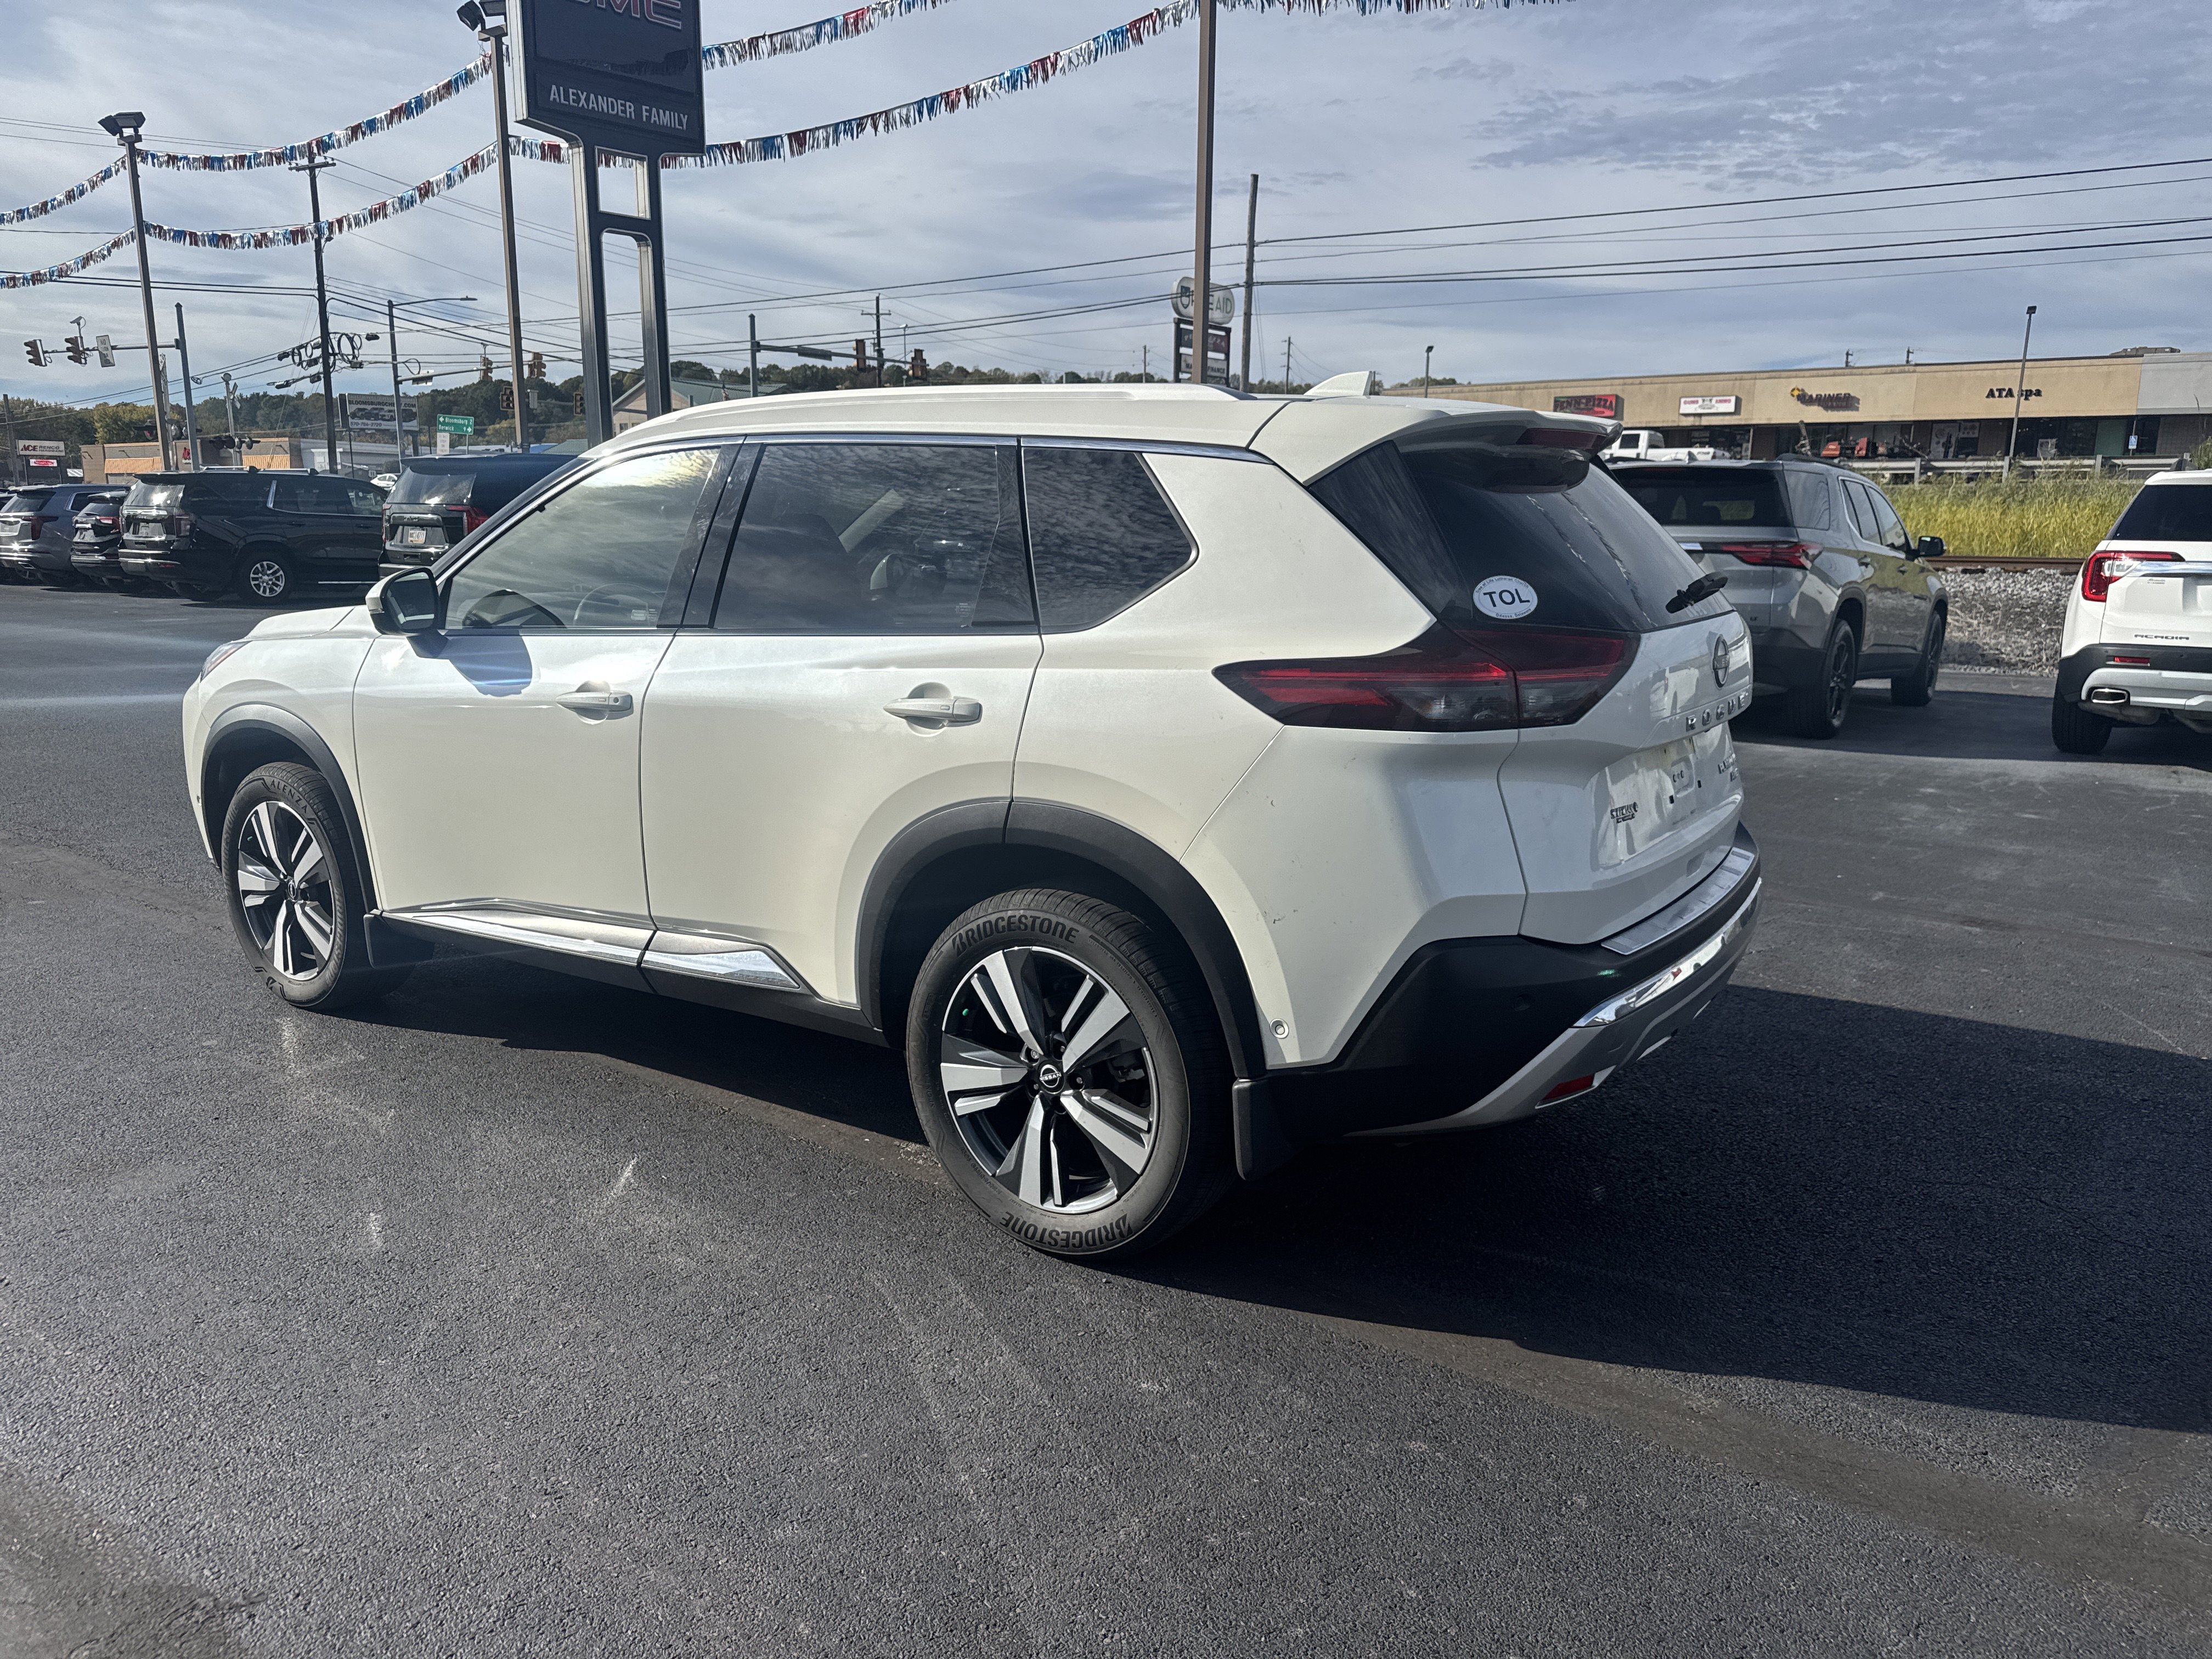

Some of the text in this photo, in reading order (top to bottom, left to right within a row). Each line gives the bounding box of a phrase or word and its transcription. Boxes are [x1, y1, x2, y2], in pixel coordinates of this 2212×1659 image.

[550, 84, 688, 131] ALEXANDER FAMILY
[1215, 297, 1233, 314] AID
[1985, 387, 2015, 398] ATA
[445, 417, 468, 425] Bloomsburg
[1483, 588, 1531, 607] TOL
[1686, 691, 1748, 732] ROGUE
[270, 779, 308, 814] ALENZA
[952, 915, 1080, 957] BRIDGESTONE
[1040, 1073, 1062, 1081] NISSAN
[1000, 1211, 1134, 1249] BRIDGESTONE
